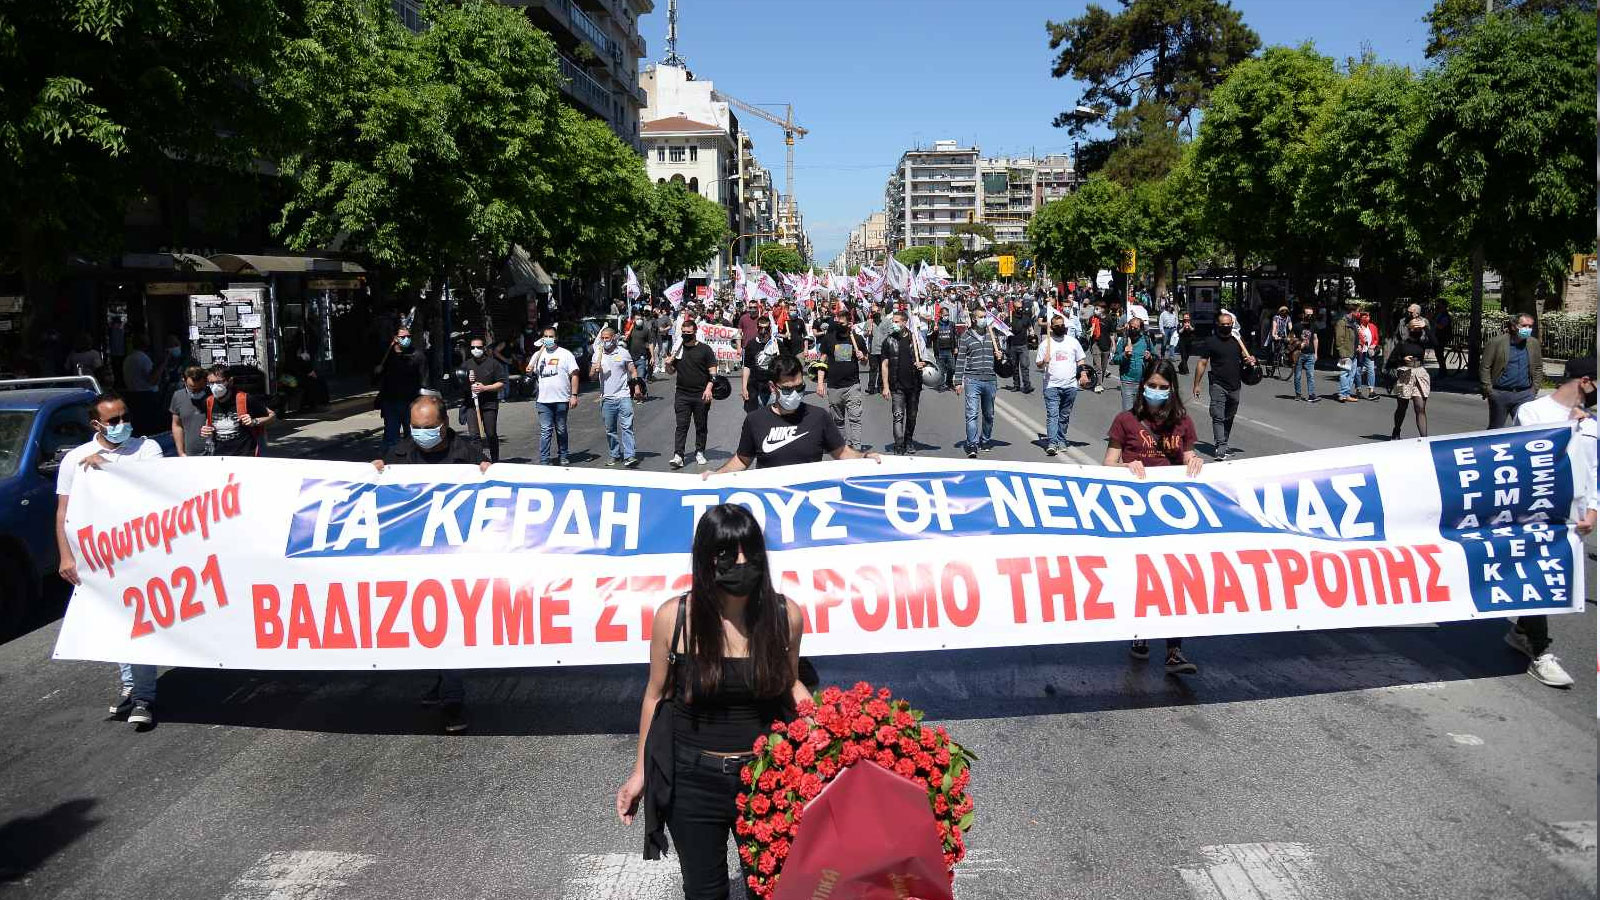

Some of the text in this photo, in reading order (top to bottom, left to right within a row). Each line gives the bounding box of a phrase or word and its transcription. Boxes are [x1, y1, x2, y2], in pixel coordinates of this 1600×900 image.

[767, 425, 798, 442] NIKE
[77, 472, 242, 578] Πρωτομαγιά
[305, 488, 380, 551] ΤΑ
[420, 486, 642, 550] ΚΕΡΔΗ
[884, 479, 954, 535] ΟΙ
[984, 475, 1223, 533] ΝΕΚΡΟΙ
[1237, 473, 1375, 539] ΜΑΣ
[122, 553, 230, 640] 2021
[252, 577, 573, 650] ΒΑΔΙΖΟΥΜΕ
[995, 555, 1116, 624] ΤΗΣ
[1133, 543, 1451, 619] ΑΝΑΤΡΟΠΗΣ
